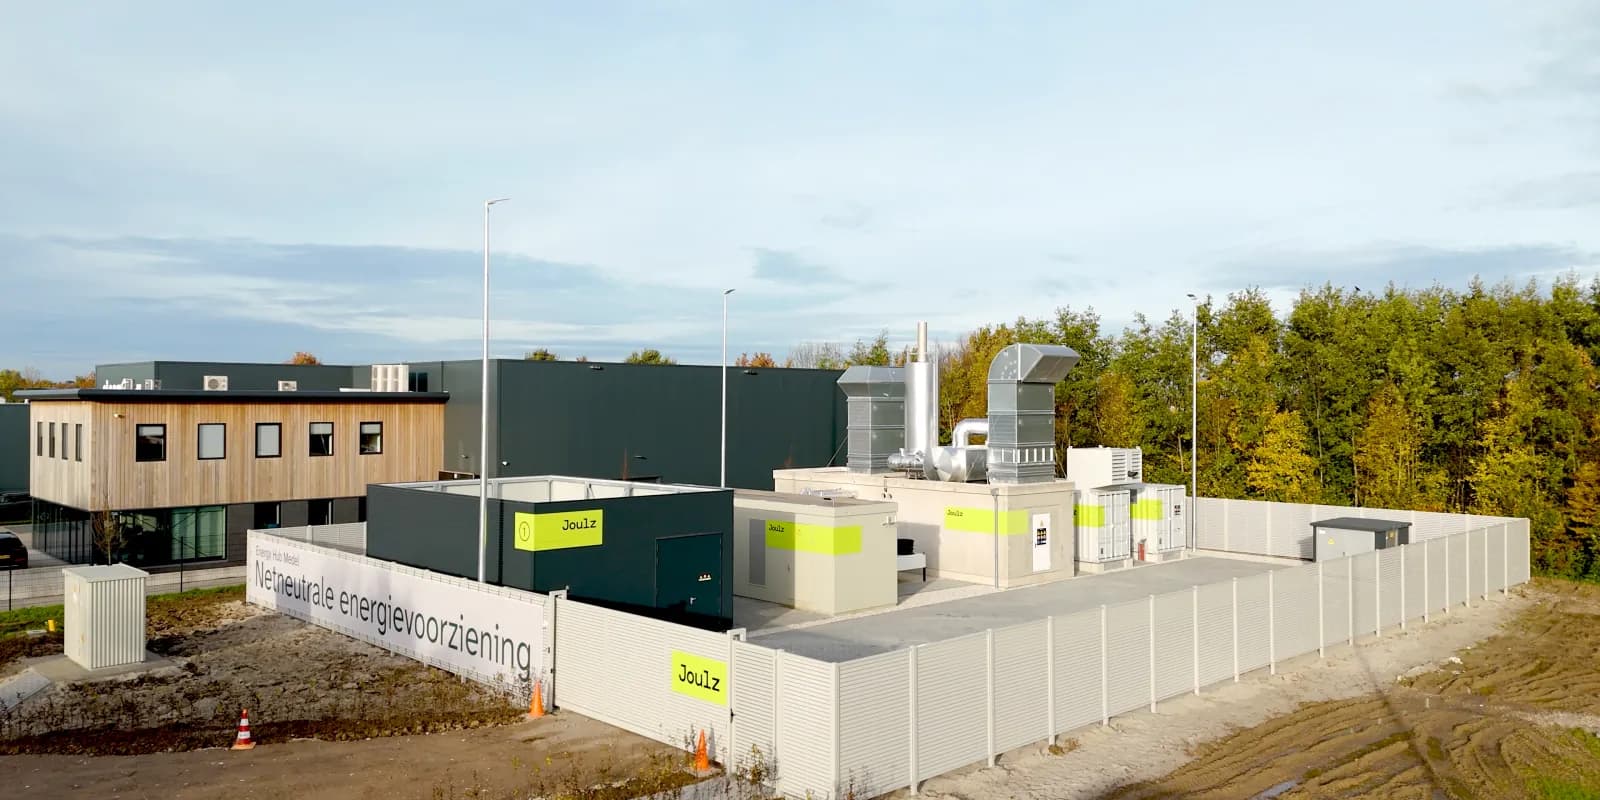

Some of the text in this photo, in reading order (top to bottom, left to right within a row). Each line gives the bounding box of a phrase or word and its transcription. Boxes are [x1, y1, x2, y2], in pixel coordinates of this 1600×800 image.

[562, 518, 597, 531] Joulz
[768, 523, 785, 533] Joulz
[255, 559, 531, 683] Netneutrale energievoorziening
[678, 663, 720, 692] Joulz
